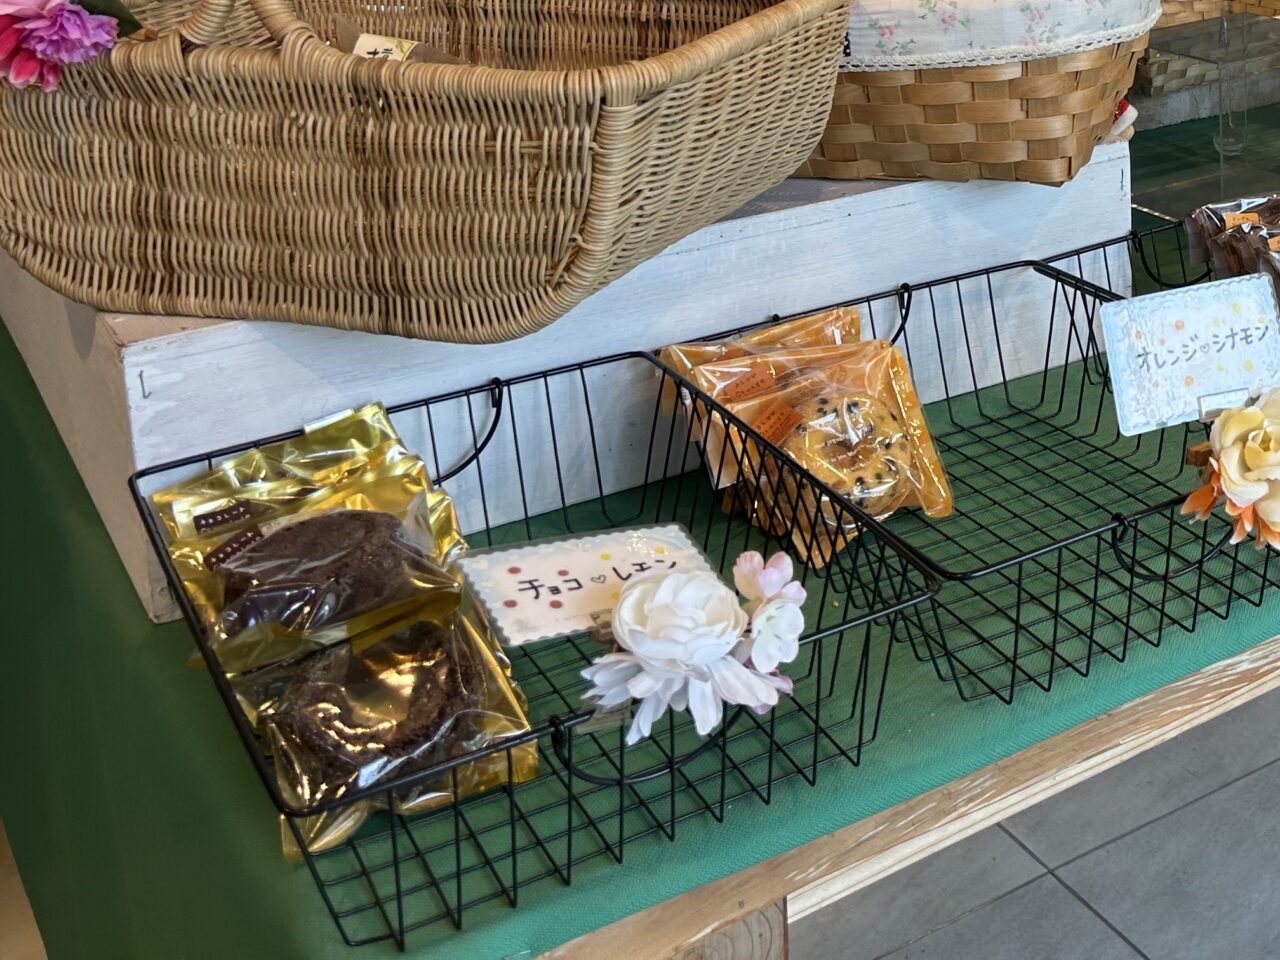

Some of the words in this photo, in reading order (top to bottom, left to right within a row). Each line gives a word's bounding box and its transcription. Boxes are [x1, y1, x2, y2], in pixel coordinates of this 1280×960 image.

[1135, 333, 1200, 373] オレンジ
[1211, 325, 1270, 354] シナモン
[200, 505, 246, 526] チョコレート
[517, 577, 584, 600] チョコ
